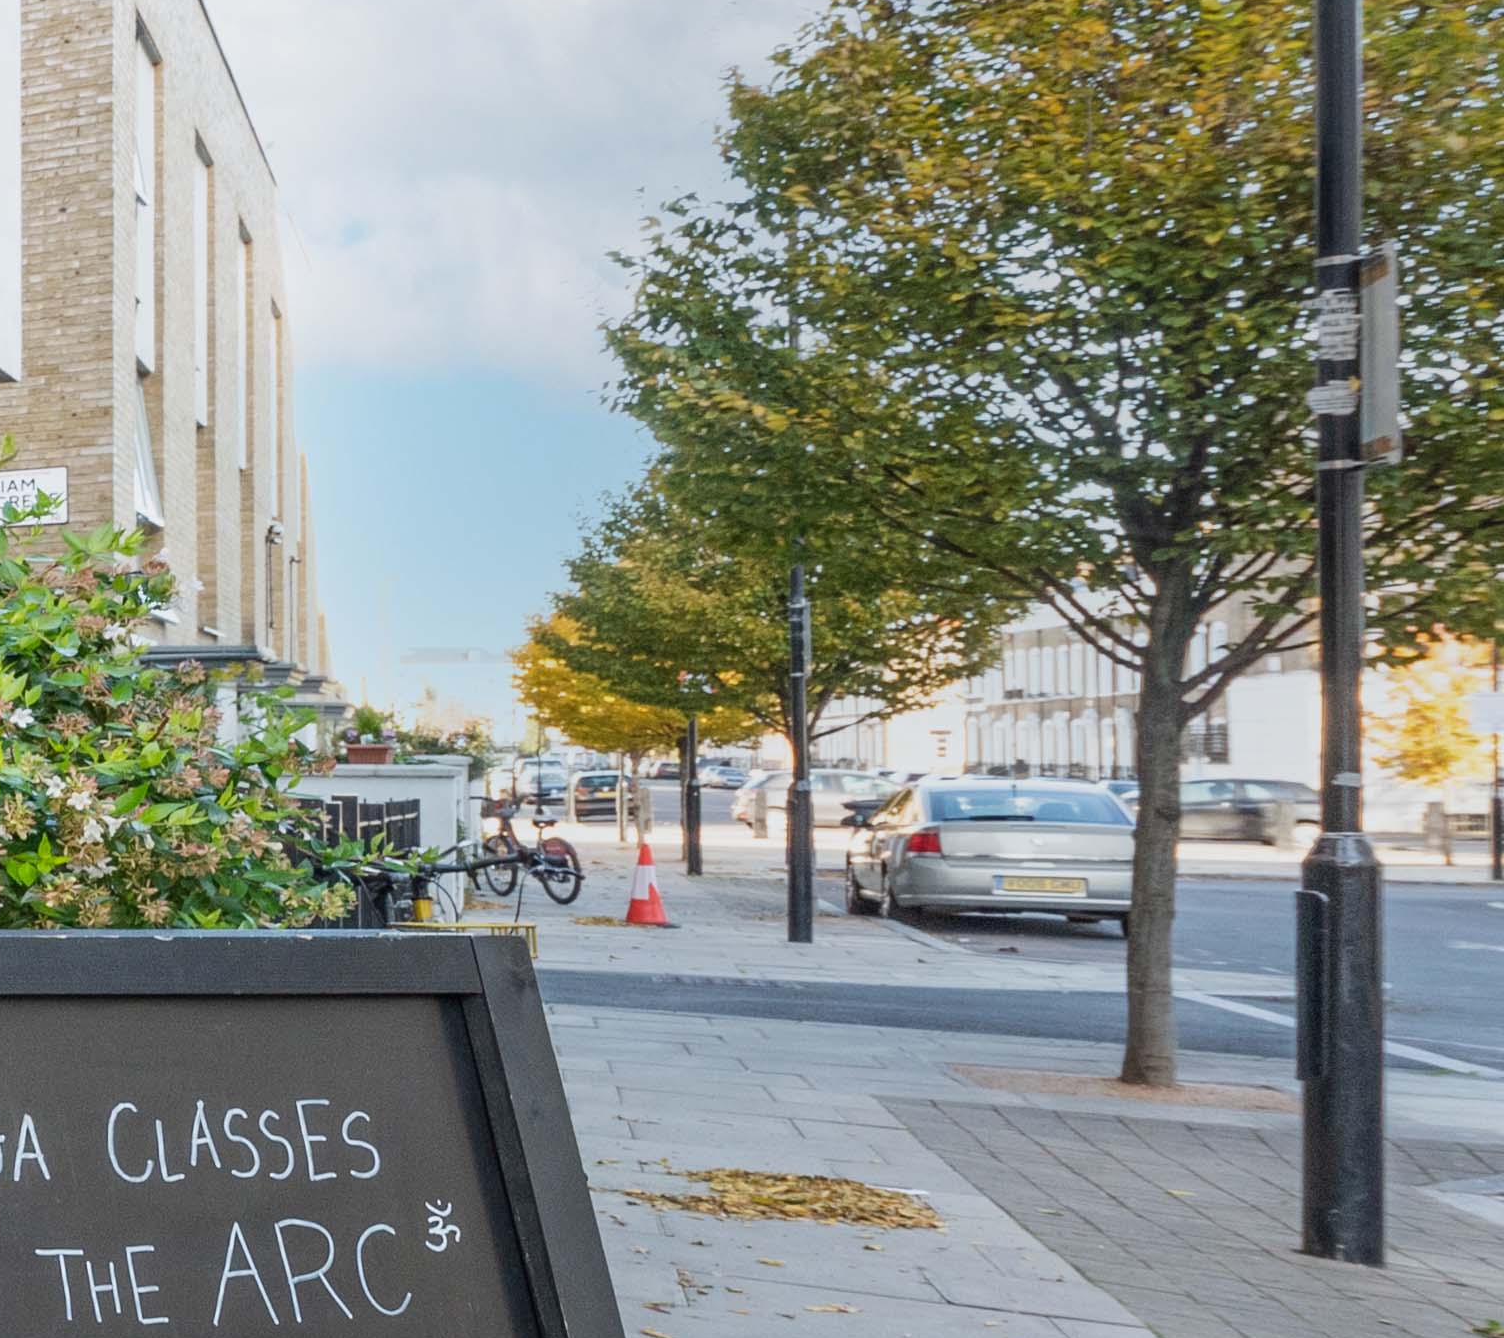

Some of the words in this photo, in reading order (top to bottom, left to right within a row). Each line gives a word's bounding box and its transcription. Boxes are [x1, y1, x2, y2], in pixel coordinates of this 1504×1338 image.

[107, 1098, 381, 1183] CLASSES
[34, 1244, 170, 1325] THE
[211, 1218, 412, 1327] ARC
